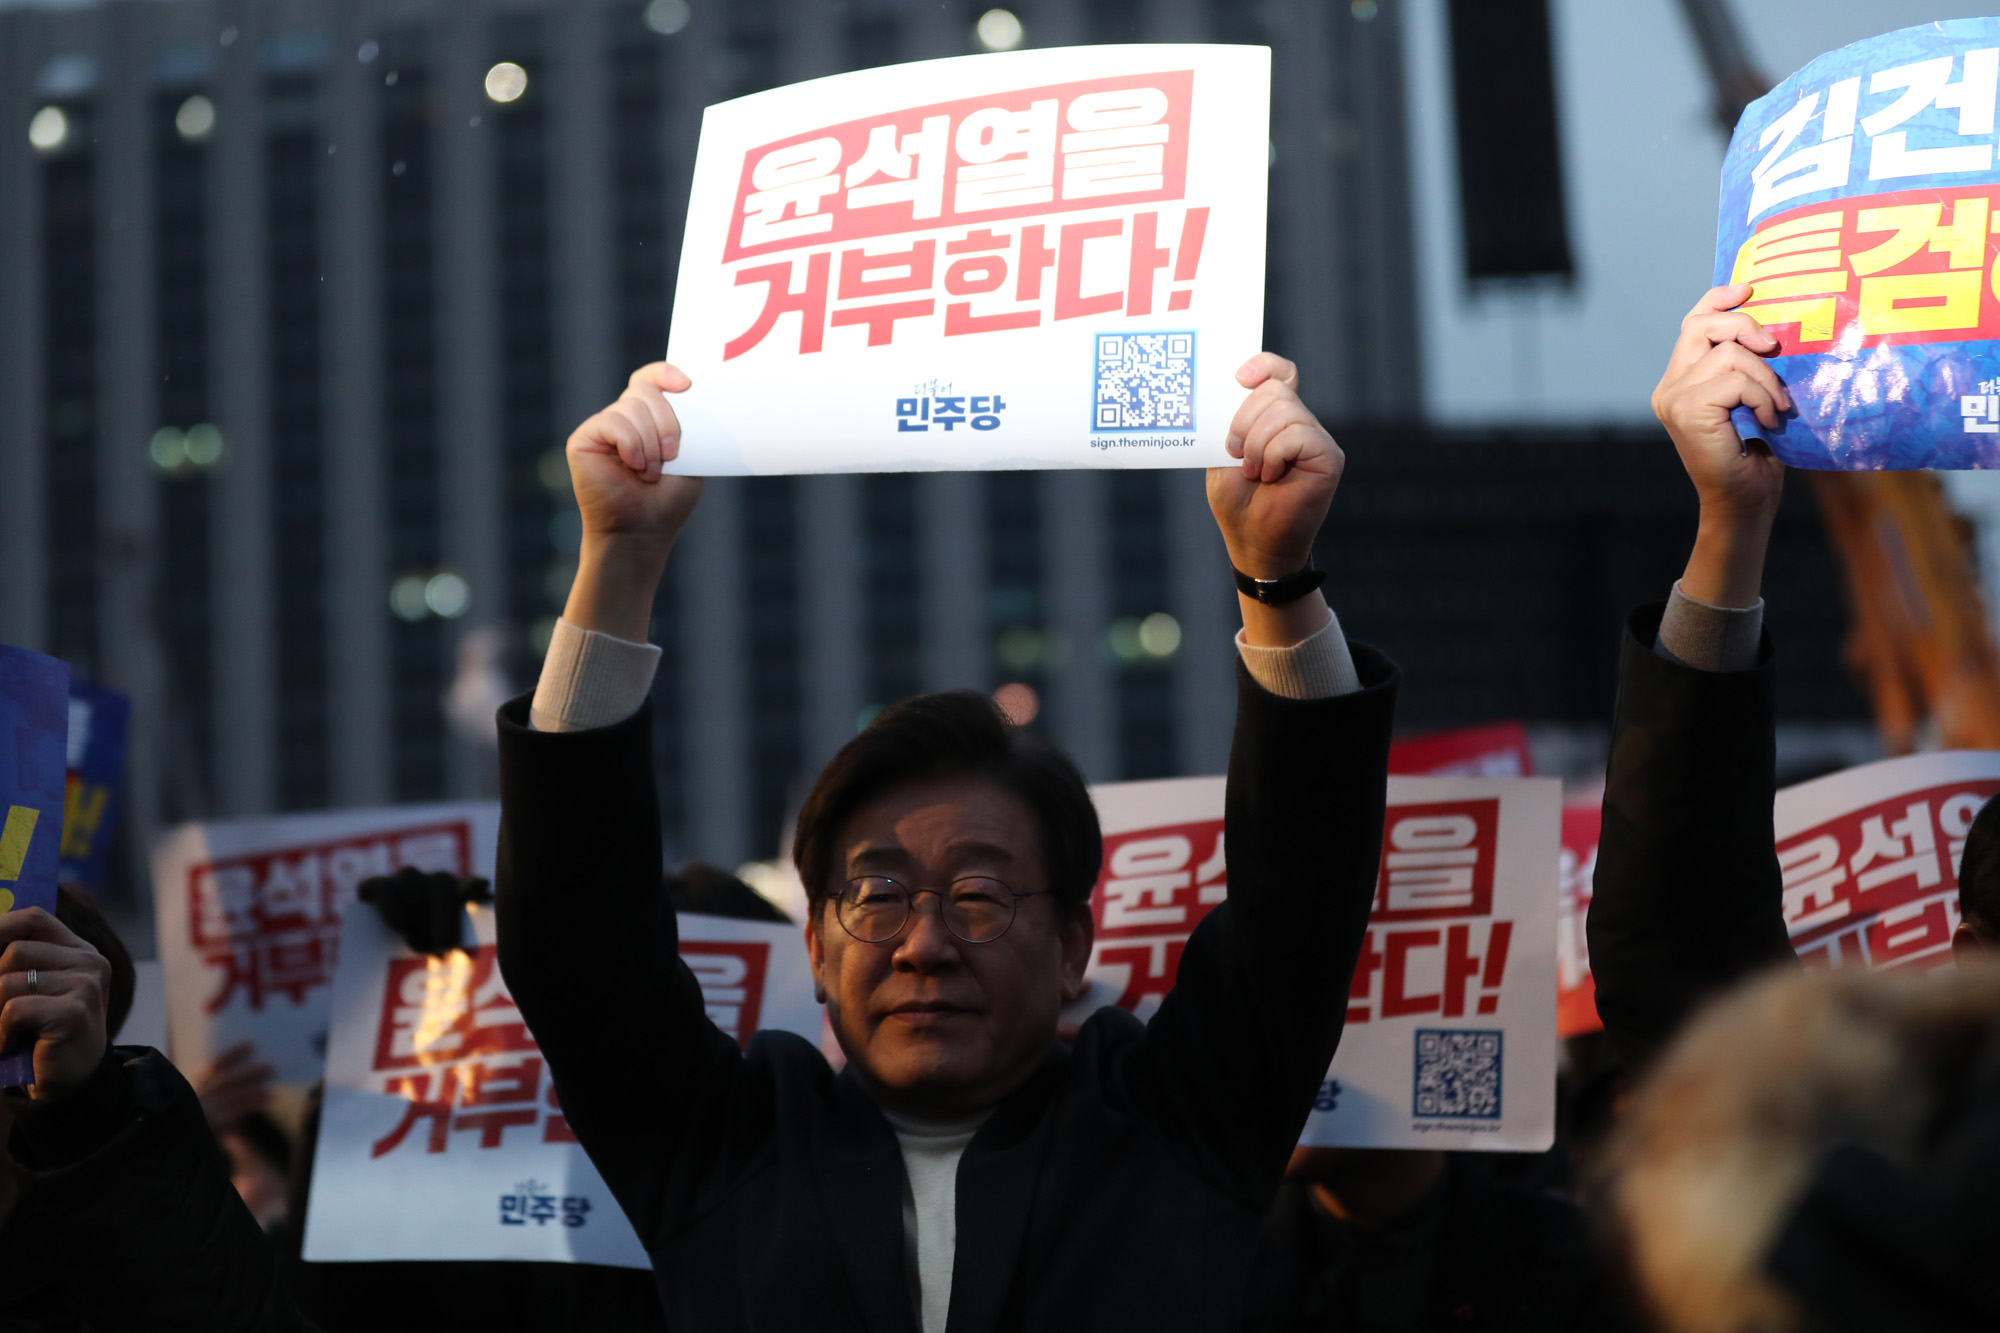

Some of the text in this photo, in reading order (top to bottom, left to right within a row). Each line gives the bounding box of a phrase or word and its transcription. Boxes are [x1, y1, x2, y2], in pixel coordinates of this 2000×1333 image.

[739, 86, 1171, 248] 윤석열을
[1747, 47, 2000, 227] 김건
[722, 206, 1211, 362] 거부한다!
[1729, 197, 2000, 344] 특검
[896, 395, 1007, 432] 민주당
[913, 378, 953, 398] 더불어
[1090, 436, 1196, 450] sign.theminjoo.kr
[500, 1195, 592, 1228] 민주당
